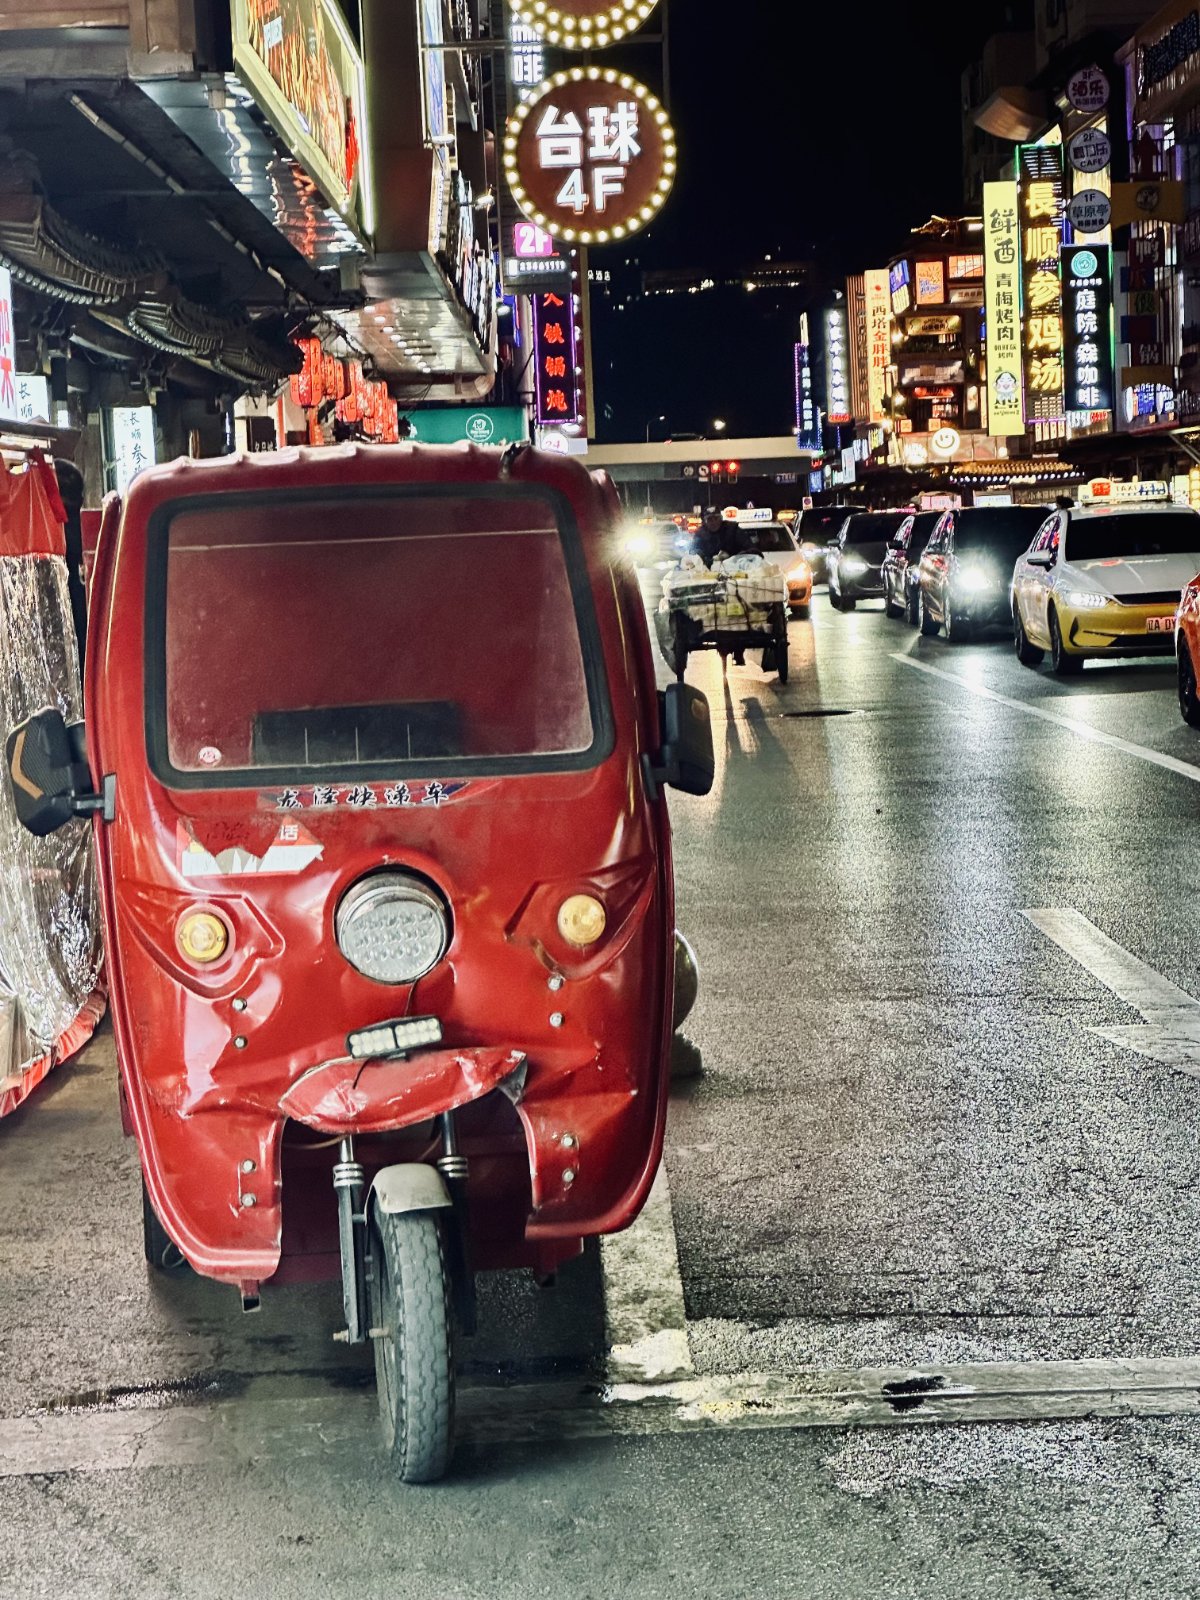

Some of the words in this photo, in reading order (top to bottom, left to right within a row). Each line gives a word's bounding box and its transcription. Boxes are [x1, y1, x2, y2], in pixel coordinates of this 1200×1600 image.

[537, 101, 640, 168] 台球
[1083, 132, 1095, 142] 2F
[556, 166, 627, 215] 4F
[1084, 193, 1096, 202] 1F
[996, 273, 1014, 341] 青梅烤肉
